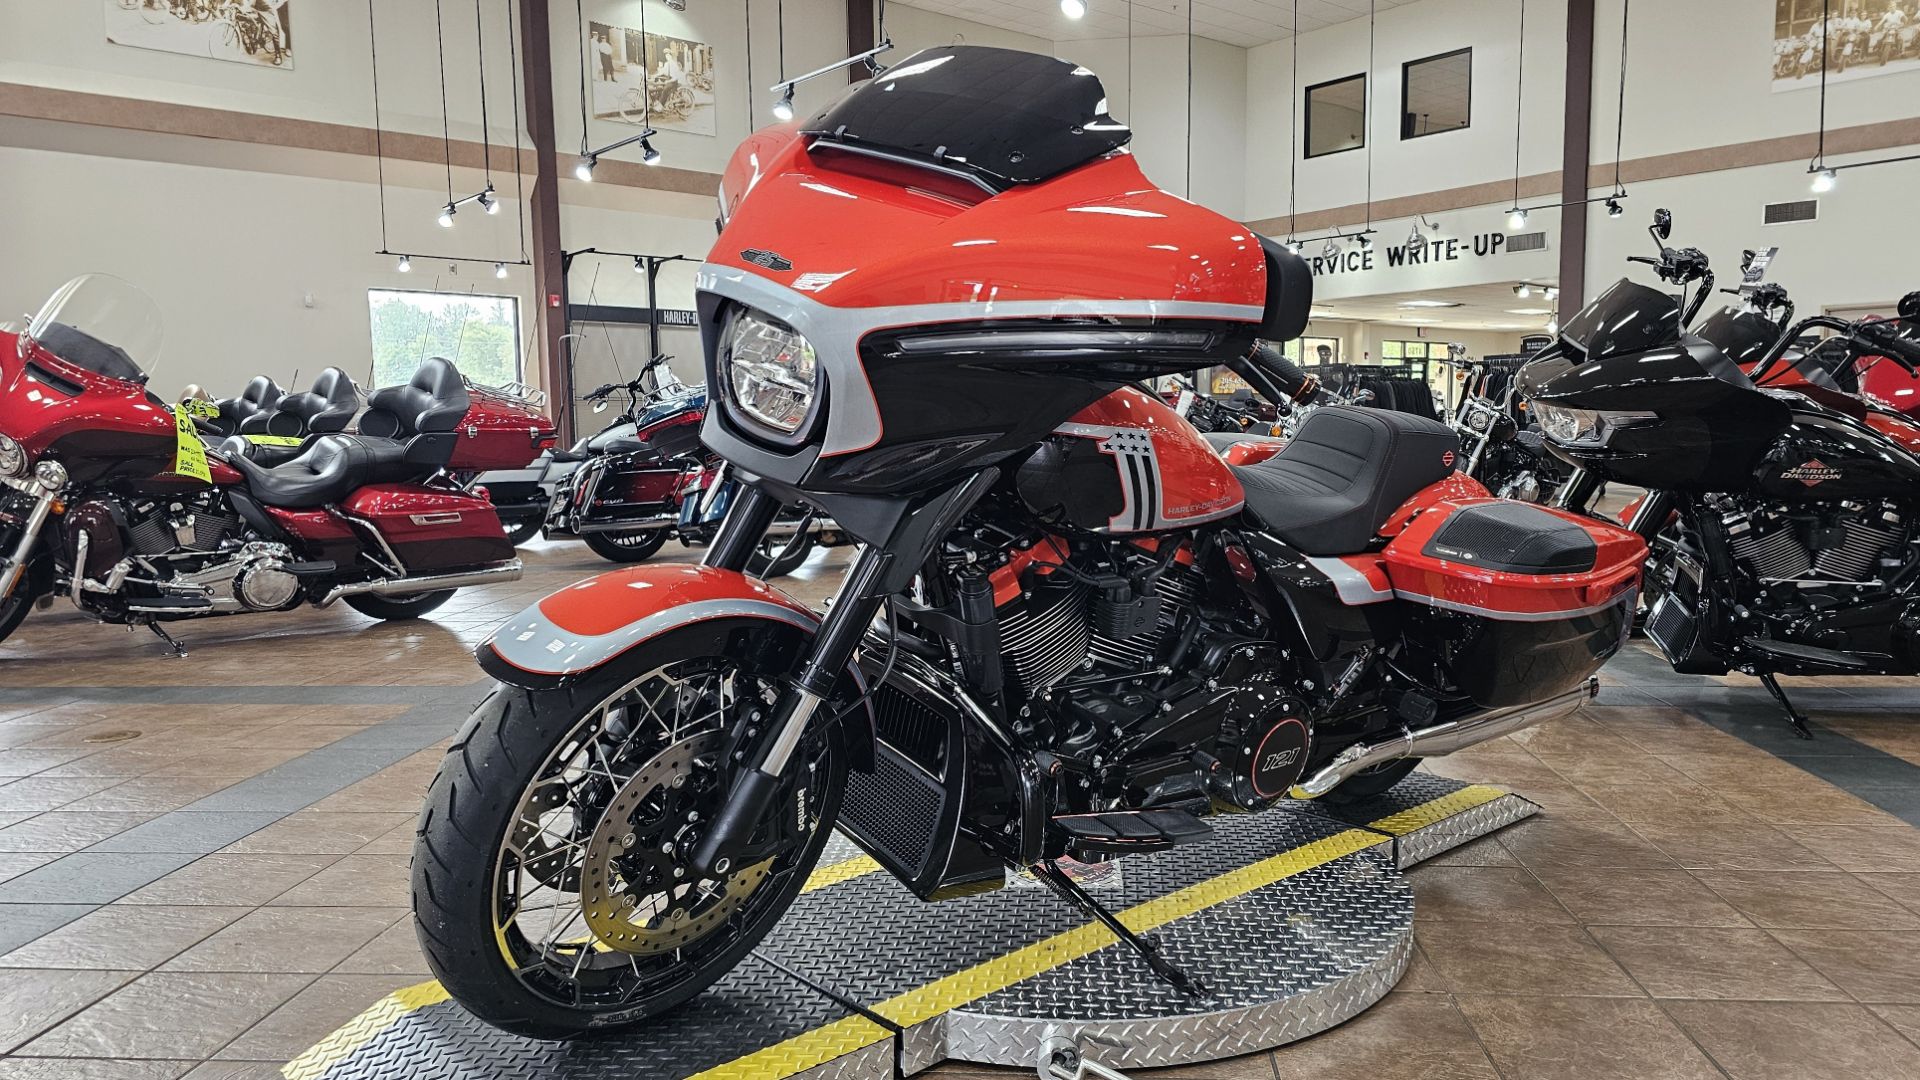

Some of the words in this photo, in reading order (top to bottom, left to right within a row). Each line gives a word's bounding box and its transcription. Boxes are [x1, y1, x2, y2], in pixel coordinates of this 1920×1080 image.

[1387, 233, 1505, 267] WRITE-UP
[179, 418, 201, 442] SAL
[1167, 496, 1232, 515] HARLEY-DAVIDSON
[1262, 747, 1301, 772] 121
[797, 787, 807, 831] brembo
